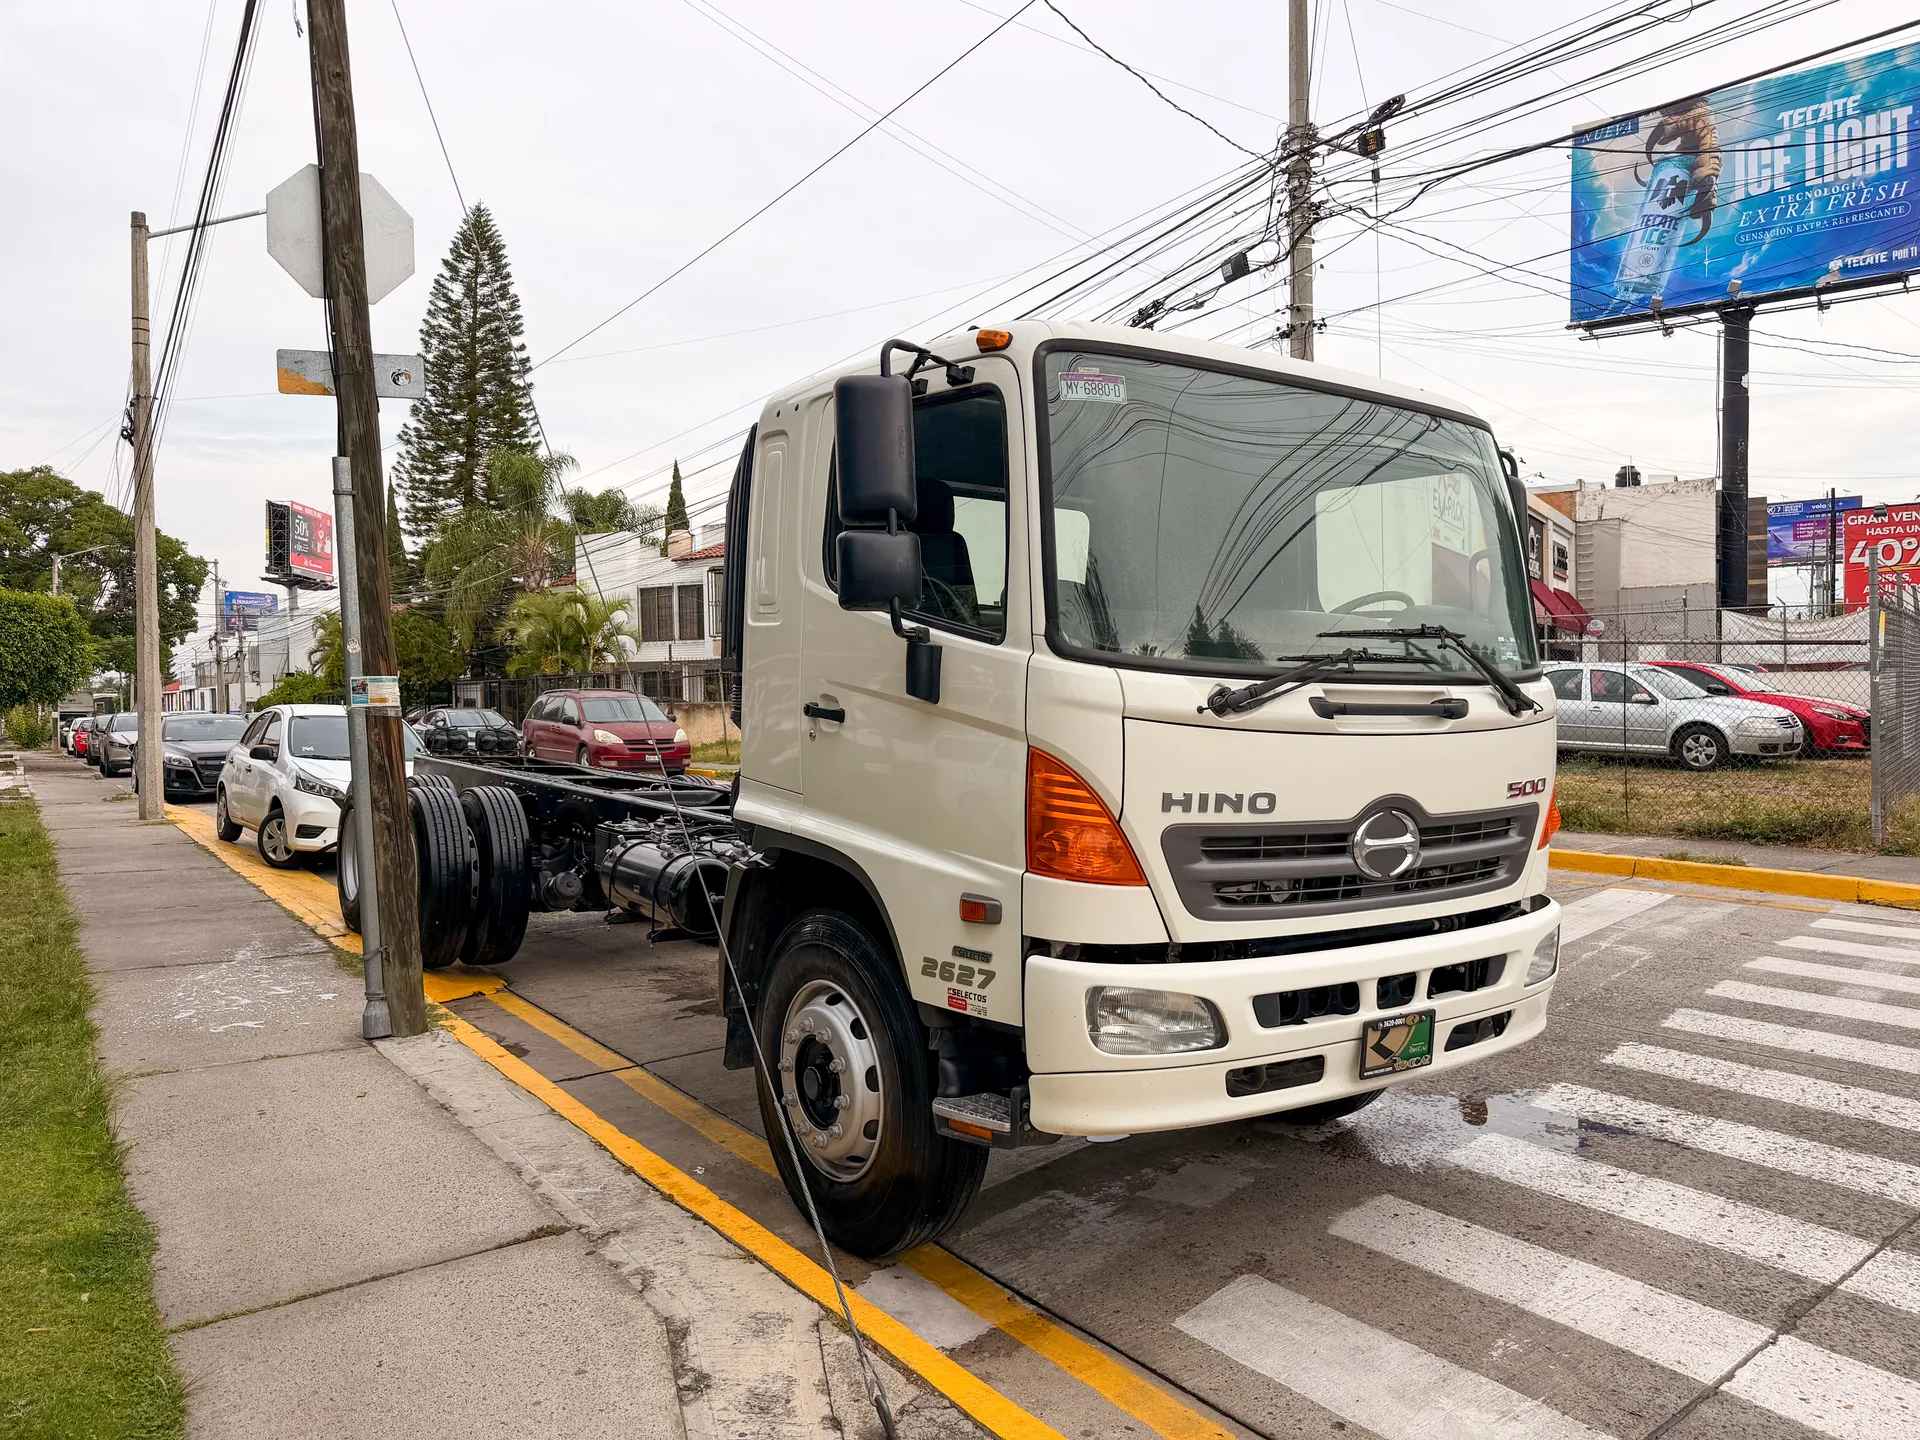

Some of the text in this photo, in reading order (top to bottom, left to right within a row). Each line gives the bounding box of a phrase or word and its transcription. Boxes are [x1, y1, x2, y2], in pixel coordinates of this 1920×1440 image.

[1777, 94, 1862, 130] TECATE
[1734, 105, 1912, 202] ICE LIGHT
[1739, 180, 1908, 228] EXTRA FRESH
[1844, 251, 1888, 269] TECATE
[1847, 513, 1889, 525] GRAN
[1866, 526, 1905, 536] HASTA
[1506, 777, 1547, 799] 500
[1160, 791, 1278, 815] HINO
[920, 956, 997, 989] 2627
[951, 988, 987, 1003] SELECTOS
